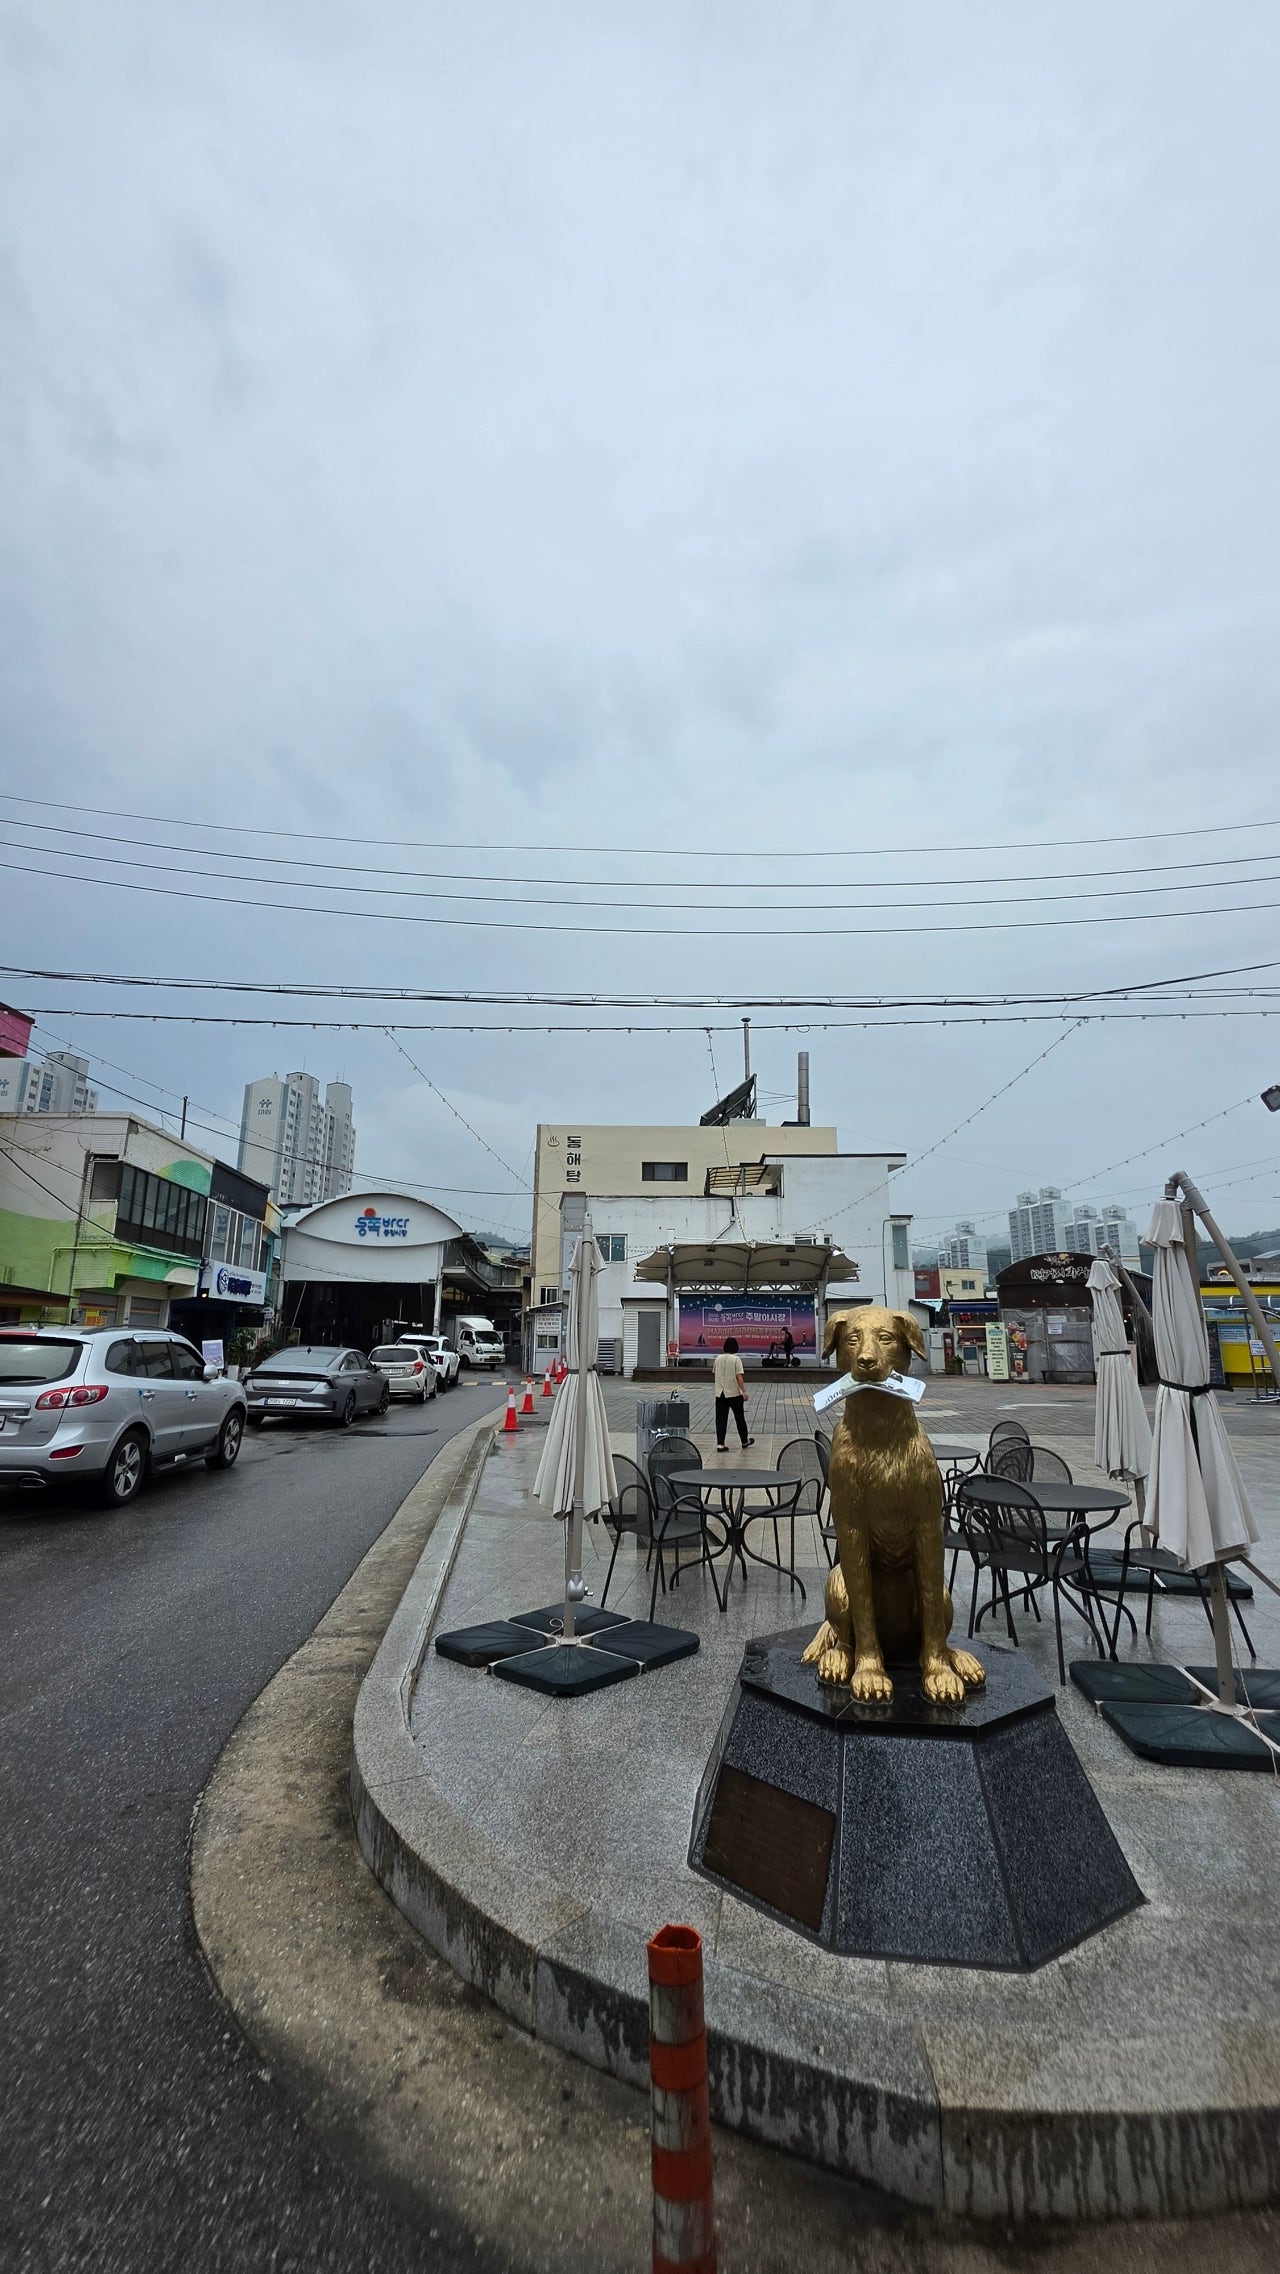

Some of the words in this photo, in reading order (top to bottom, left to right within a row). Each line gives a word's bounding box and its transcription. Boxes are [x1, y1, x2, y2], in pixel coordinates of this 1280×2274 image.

[566, 1136, 582, 1183] 동해탕
[745, 1312, 786, 1323] 주말야시장
[708, 1327, 734, 1335] MARINE
[735, 1327, 765, 1335] SUMMER
